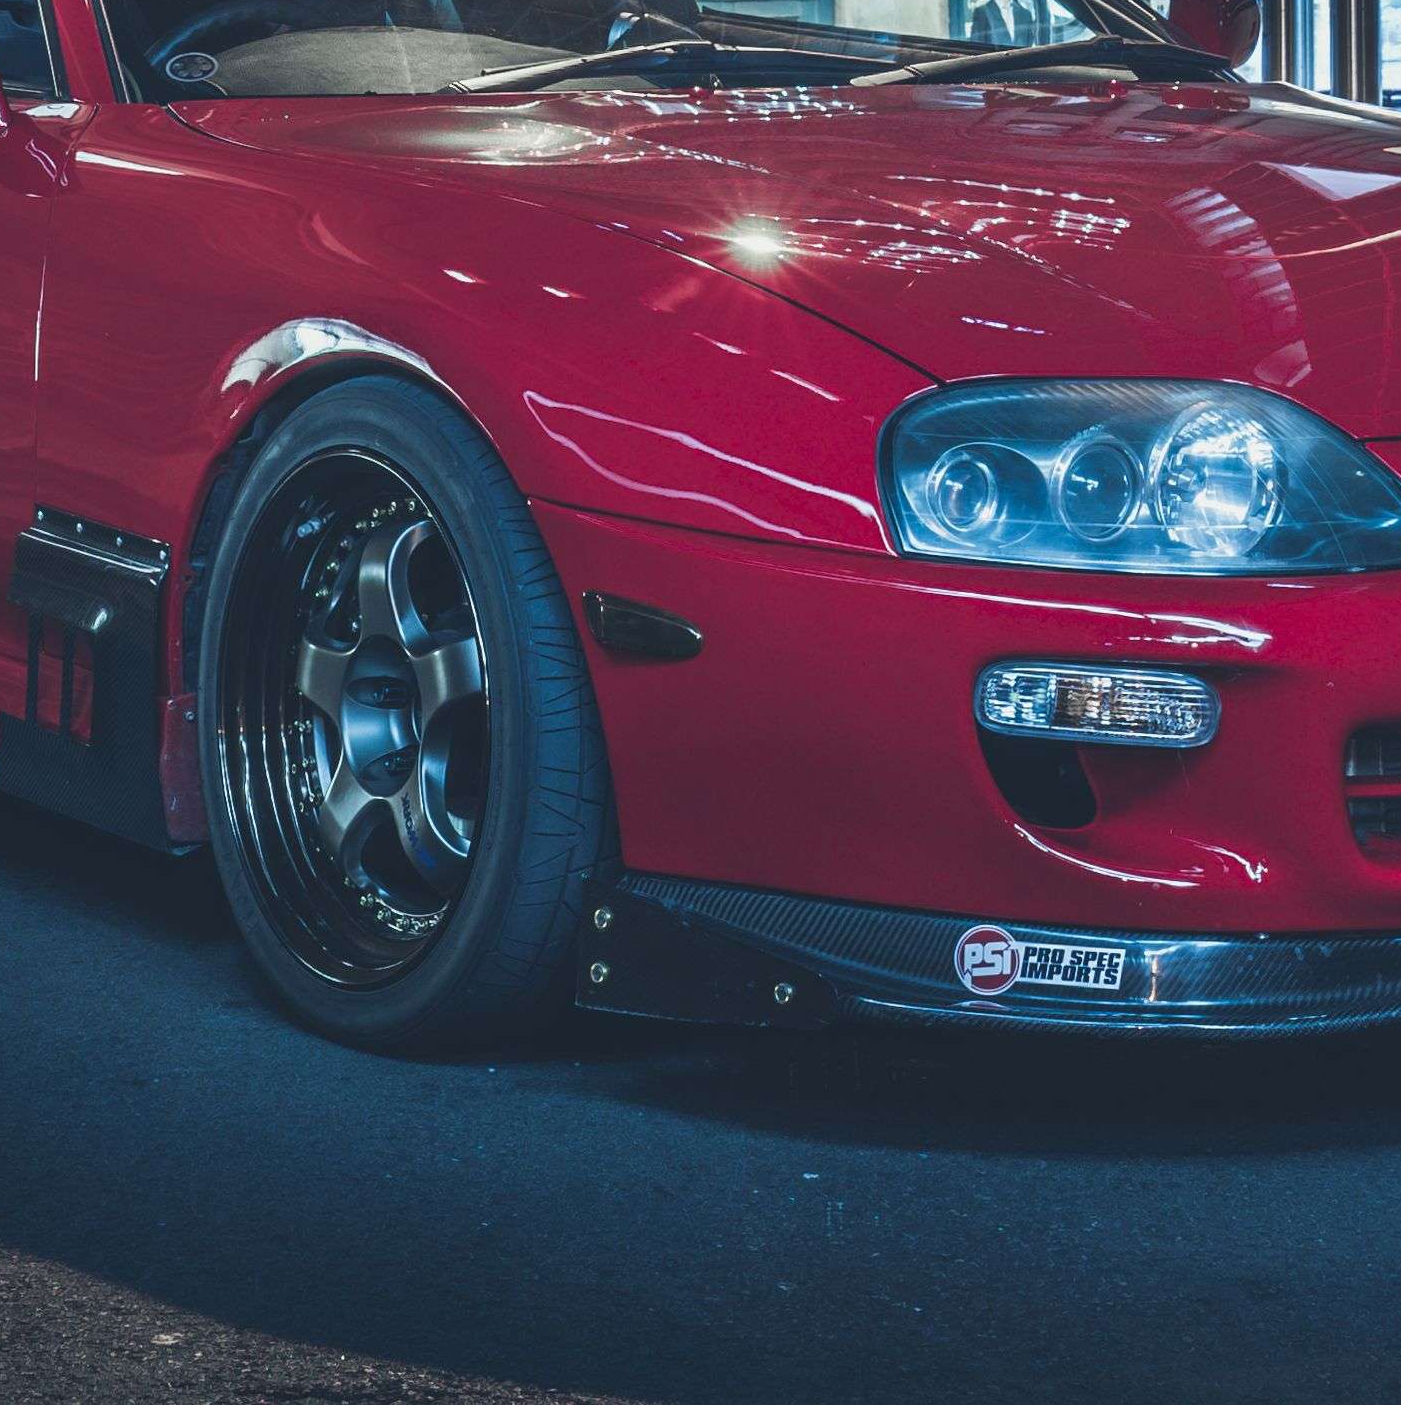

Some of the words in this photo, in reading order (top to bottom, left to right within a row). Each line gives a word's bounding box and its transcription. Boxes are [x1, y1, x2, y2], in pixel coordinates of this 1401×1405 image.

[1023, 946, 1065, 965] PRO
[1070, 949, 1121, 969] SPEC
[1020, 962, 1119, 985] IMPORTS
